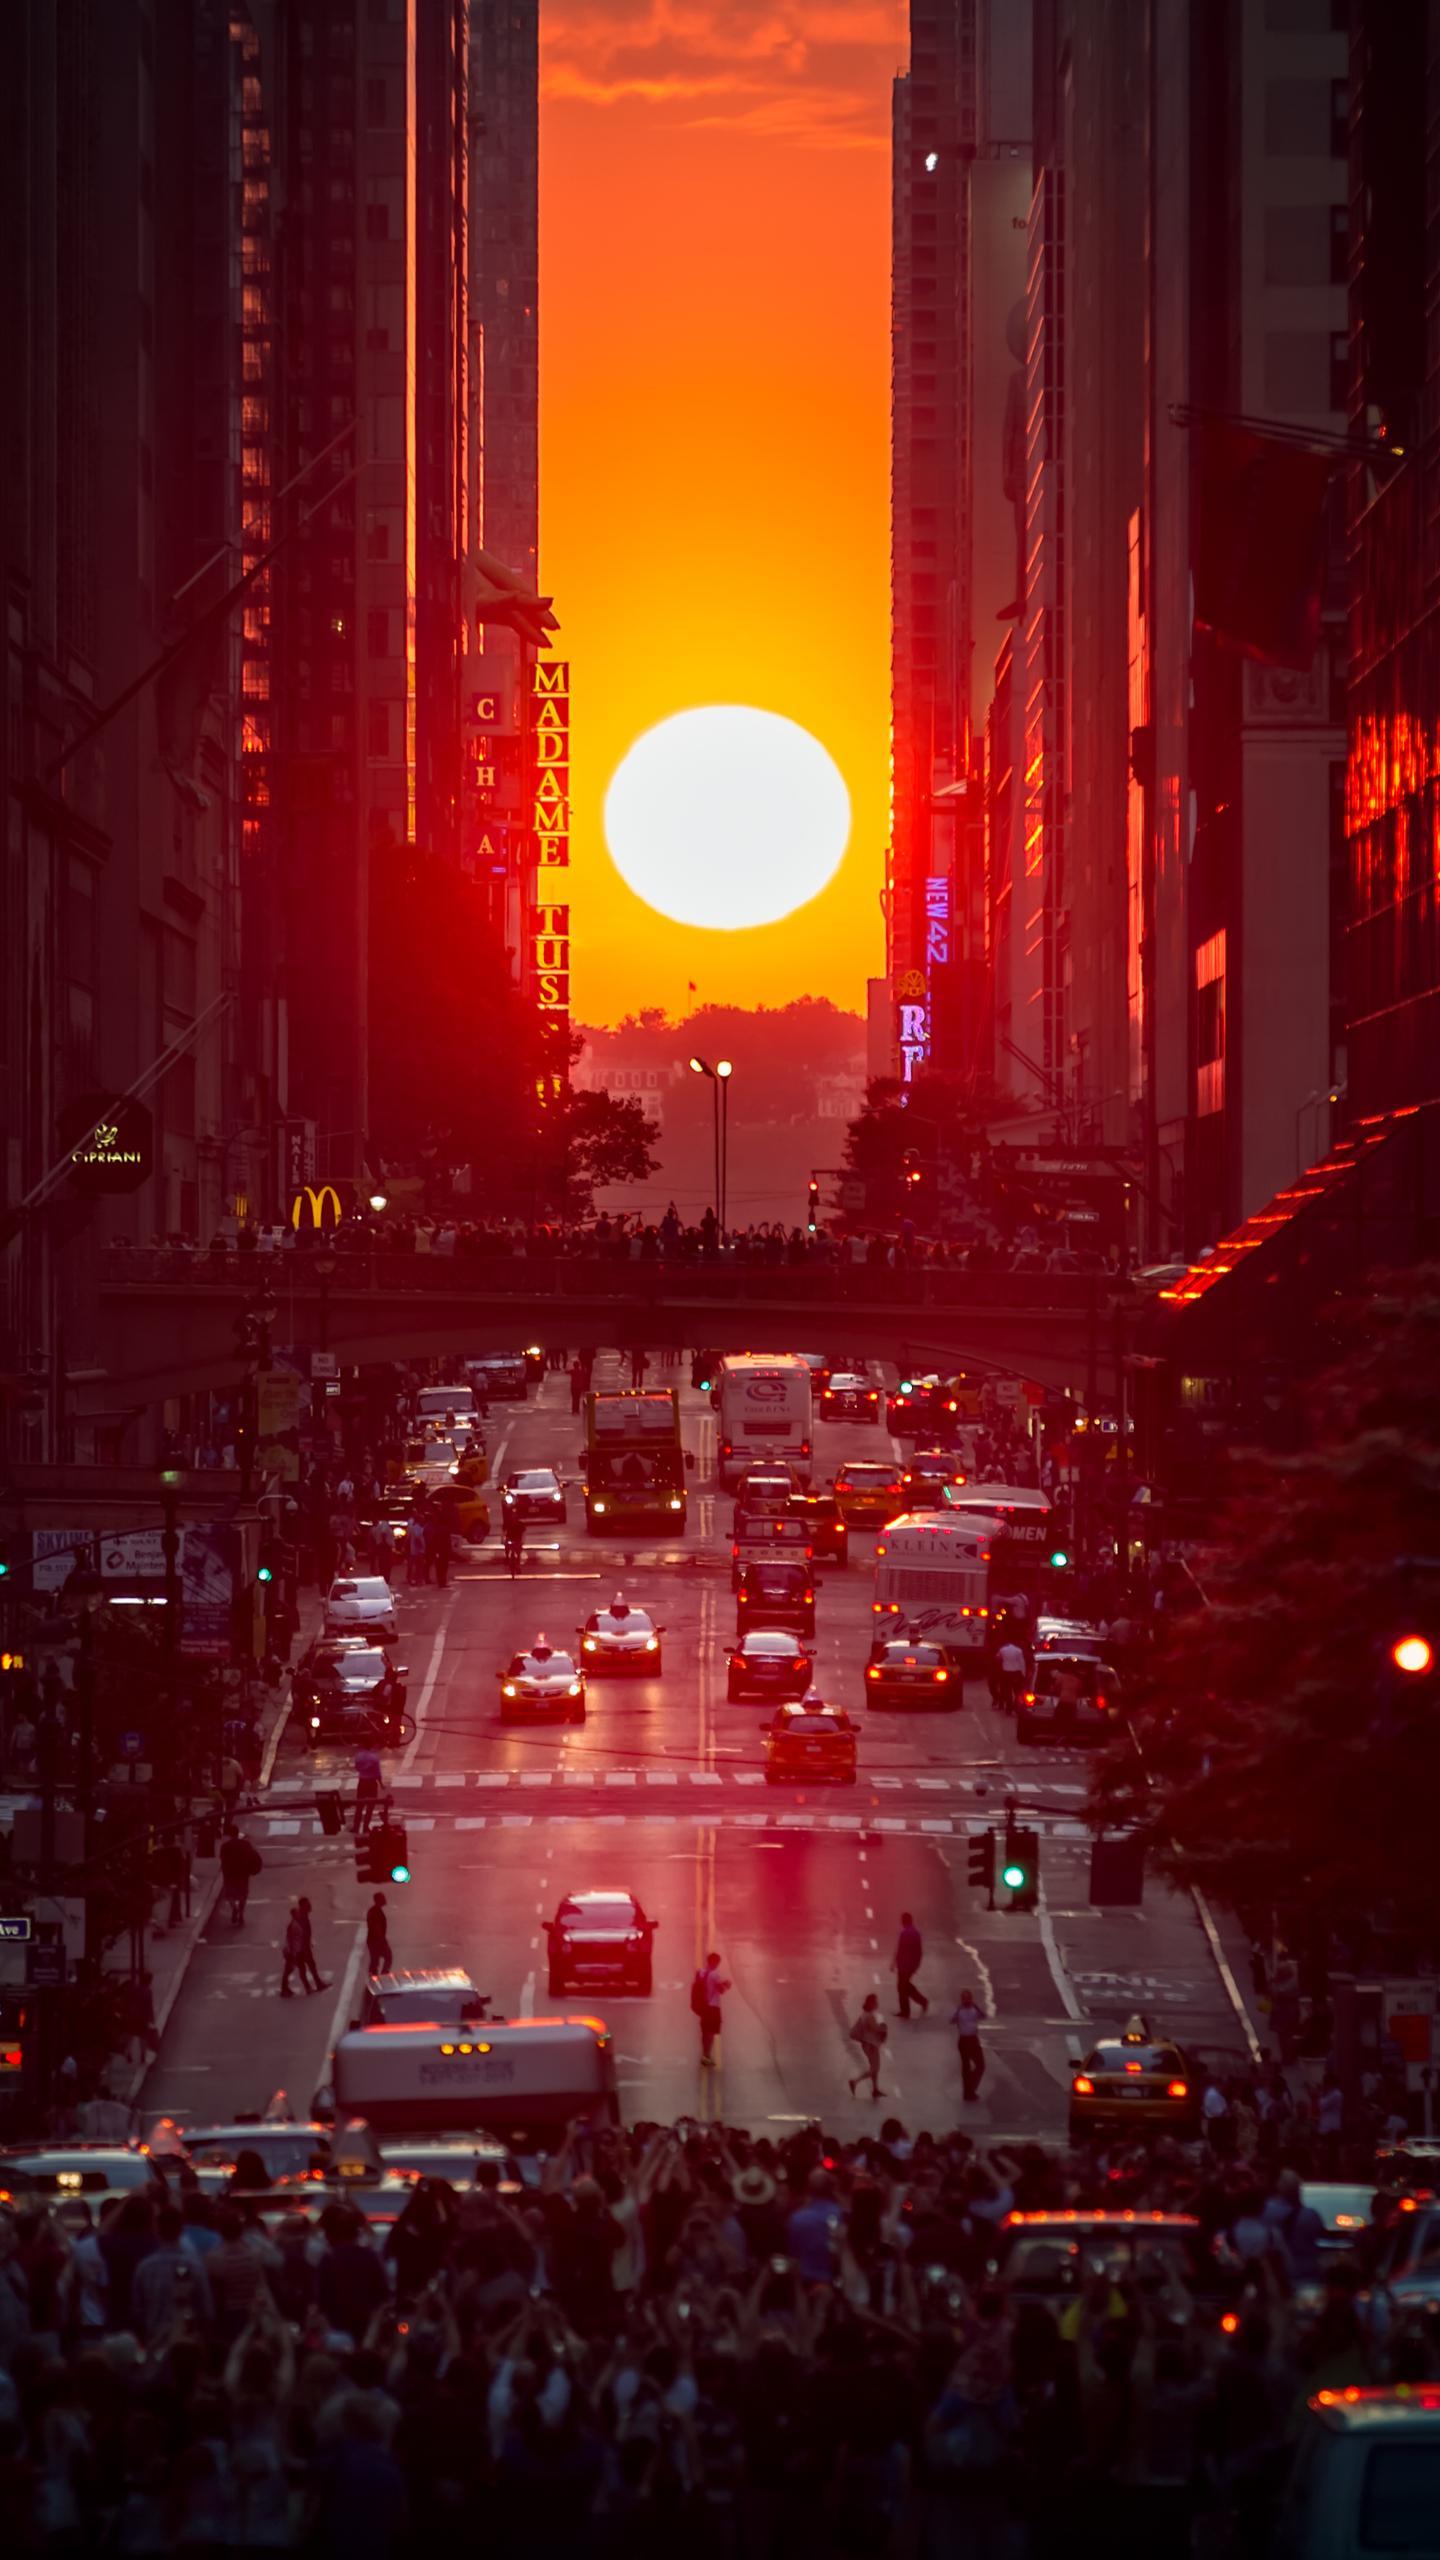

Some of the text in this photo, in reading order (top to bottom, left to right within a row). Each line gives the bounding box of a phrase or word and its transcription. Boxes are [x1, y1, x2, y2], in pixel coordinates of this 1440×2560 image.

[476, 698, 496, 854] CHA
[532, 663, 566, 1038] MADAME TUS
[926, 877, 949, 963] NEW 42
[72, 1151, 141, 1163] CIPRIANI
[891, 1539, 950, 1552] KLEIN
[0, 1922, 20, 1936] Ave
